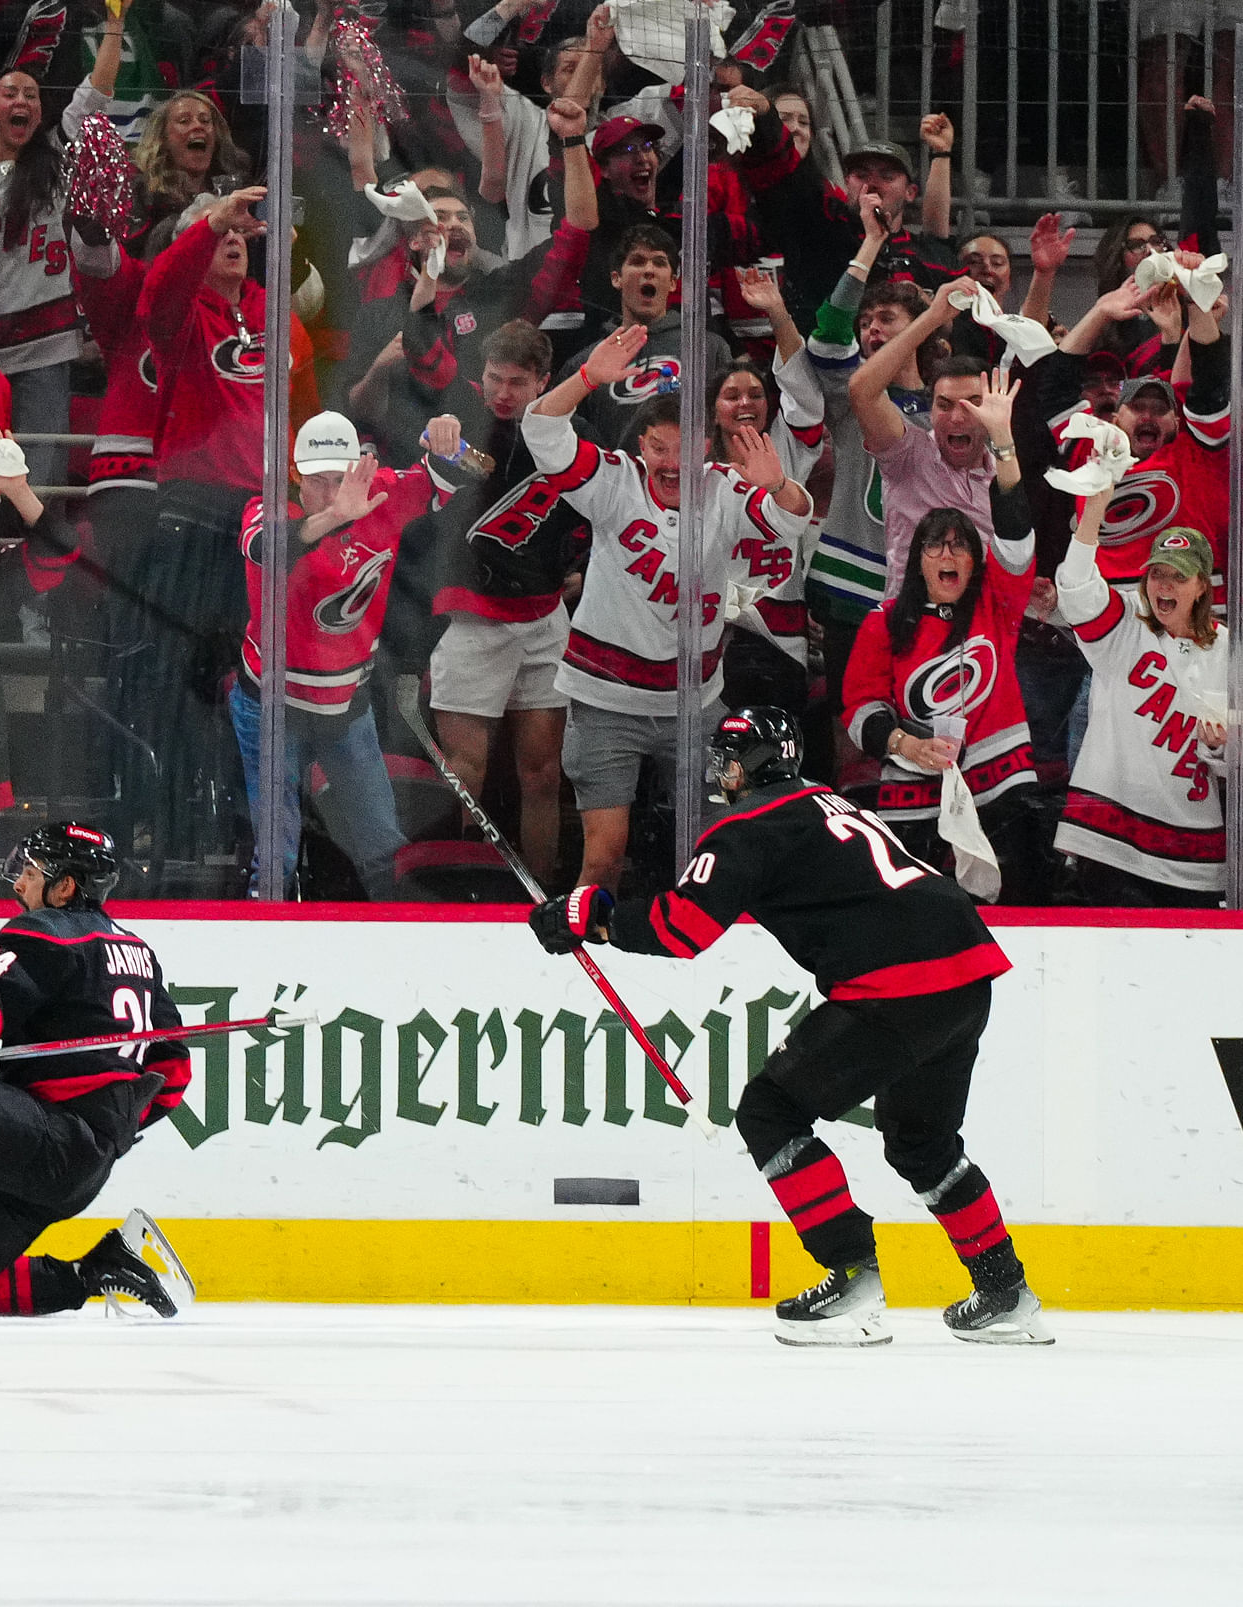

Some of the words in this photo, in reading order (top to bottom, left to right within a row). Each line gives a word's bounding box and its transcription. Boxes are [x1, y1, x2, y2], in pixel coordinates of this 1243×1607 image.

[1128, 650, 1209, 802] CANES
[781, 740, 796, 759] 20
[69, 827, 101, 842] Lenovo
[104, 943, 154, 979] JARVIS
